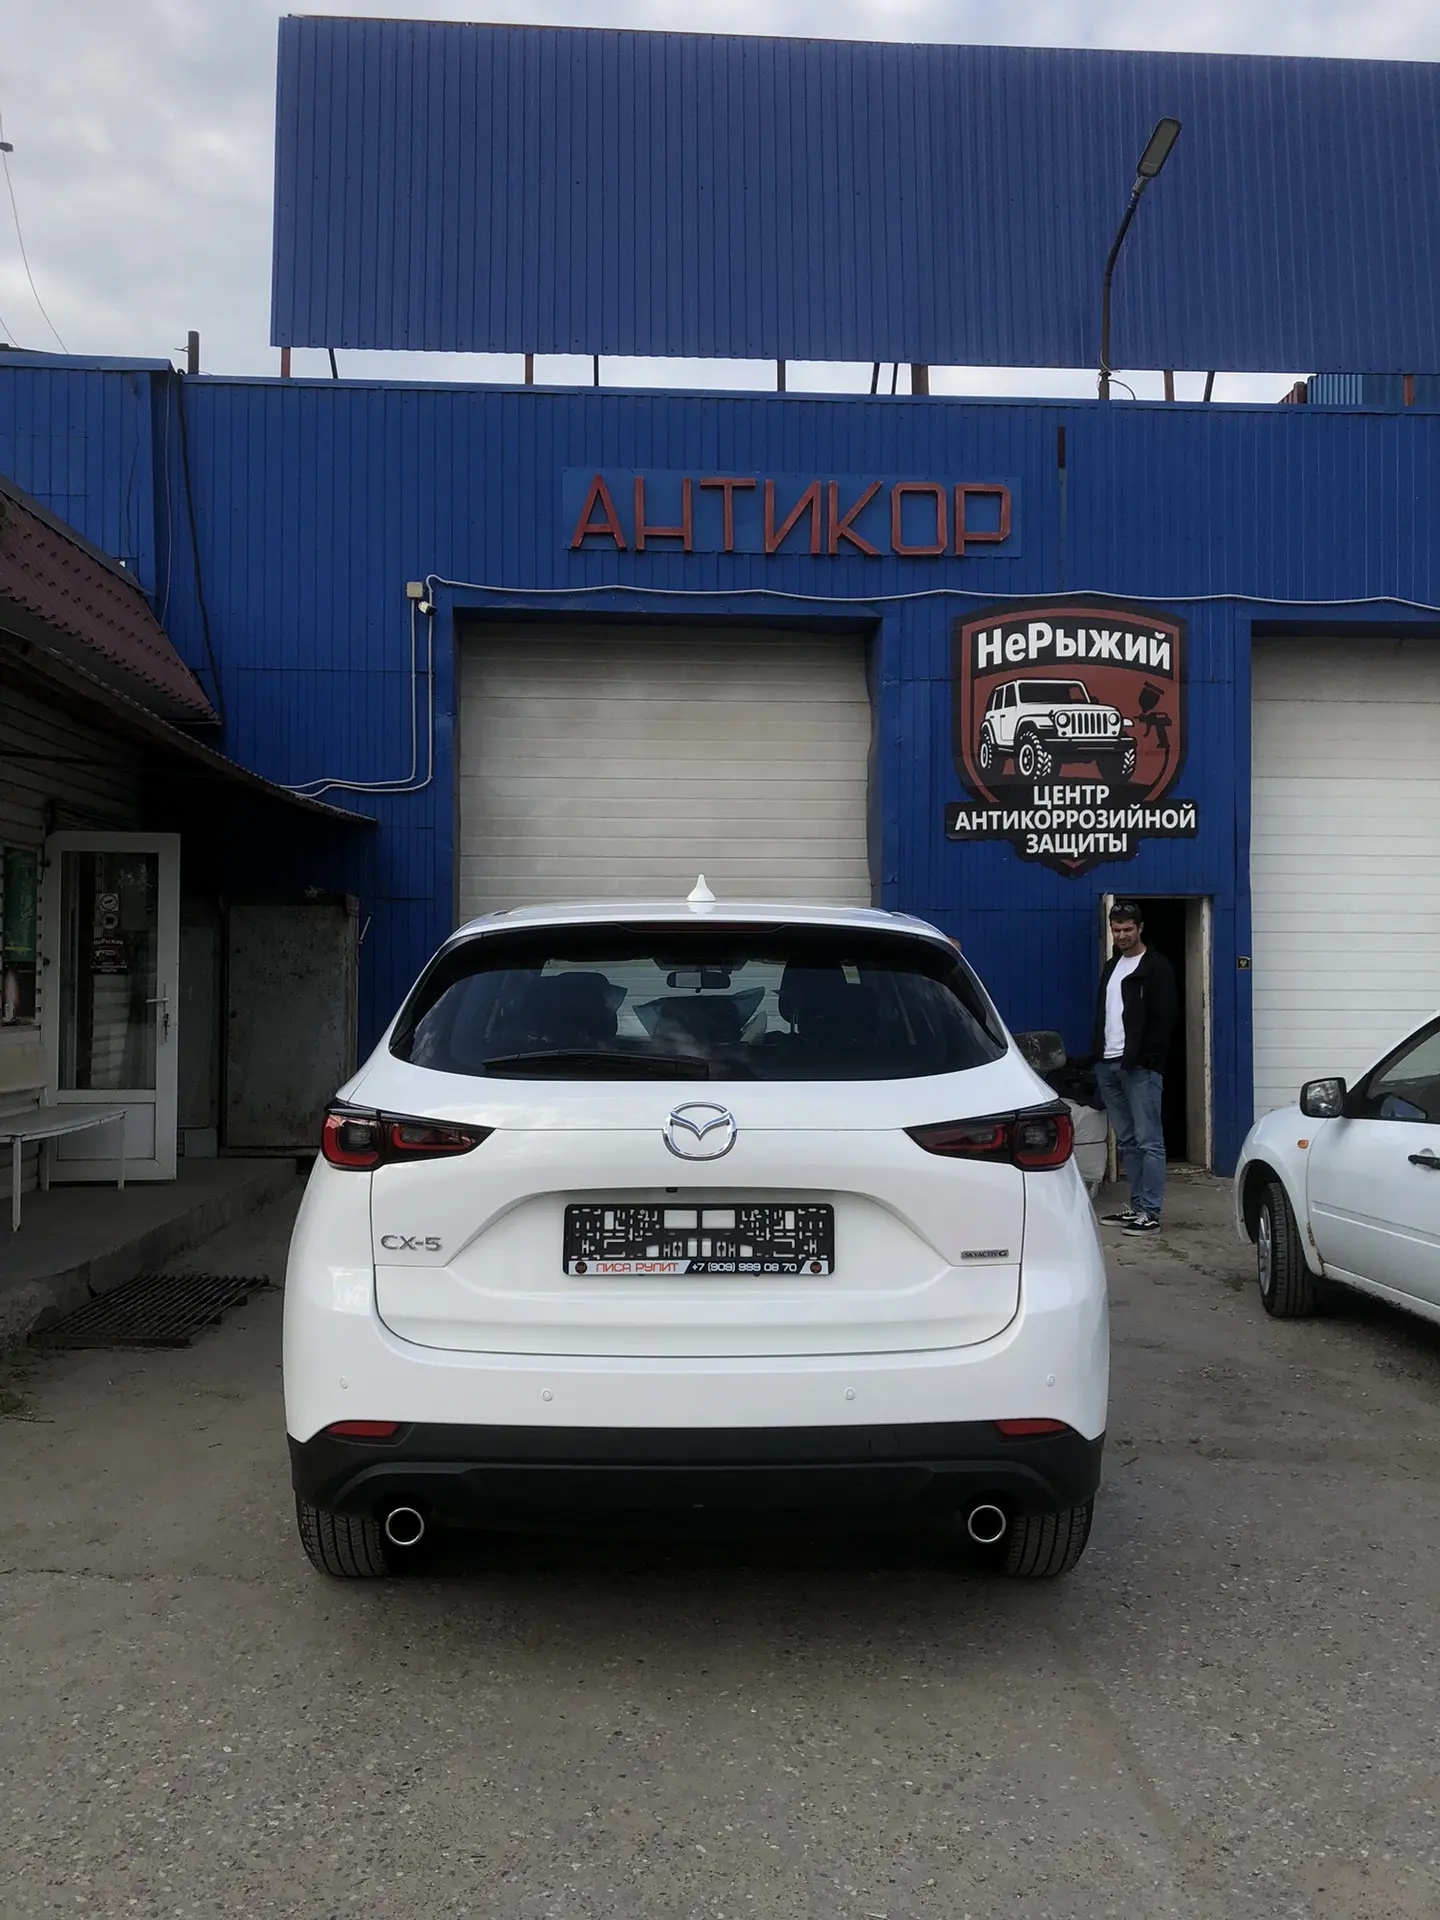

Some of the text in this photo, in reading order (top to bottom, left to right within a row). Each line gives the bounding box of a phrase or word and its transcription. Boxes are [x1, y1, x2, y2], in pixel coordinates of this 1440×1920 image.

[571, 474, 1011, 556] АНТИКОР
[977, 622, 1172, 671] НеРыжий
[1033, 785, 1110, 809] ЦЕНТР
[955, 803, 1196, 831] АНТИКОРРОЗИЙНОЙ
[1026, 833, 1128, 857] ЗАЩИТЫ
[381, 1235, 442, 1251] CX-5
[635, 1262, 680, 1273] РУЛИТ
[691, 1261, 798, 1273] +7 (909) 999 08 70
